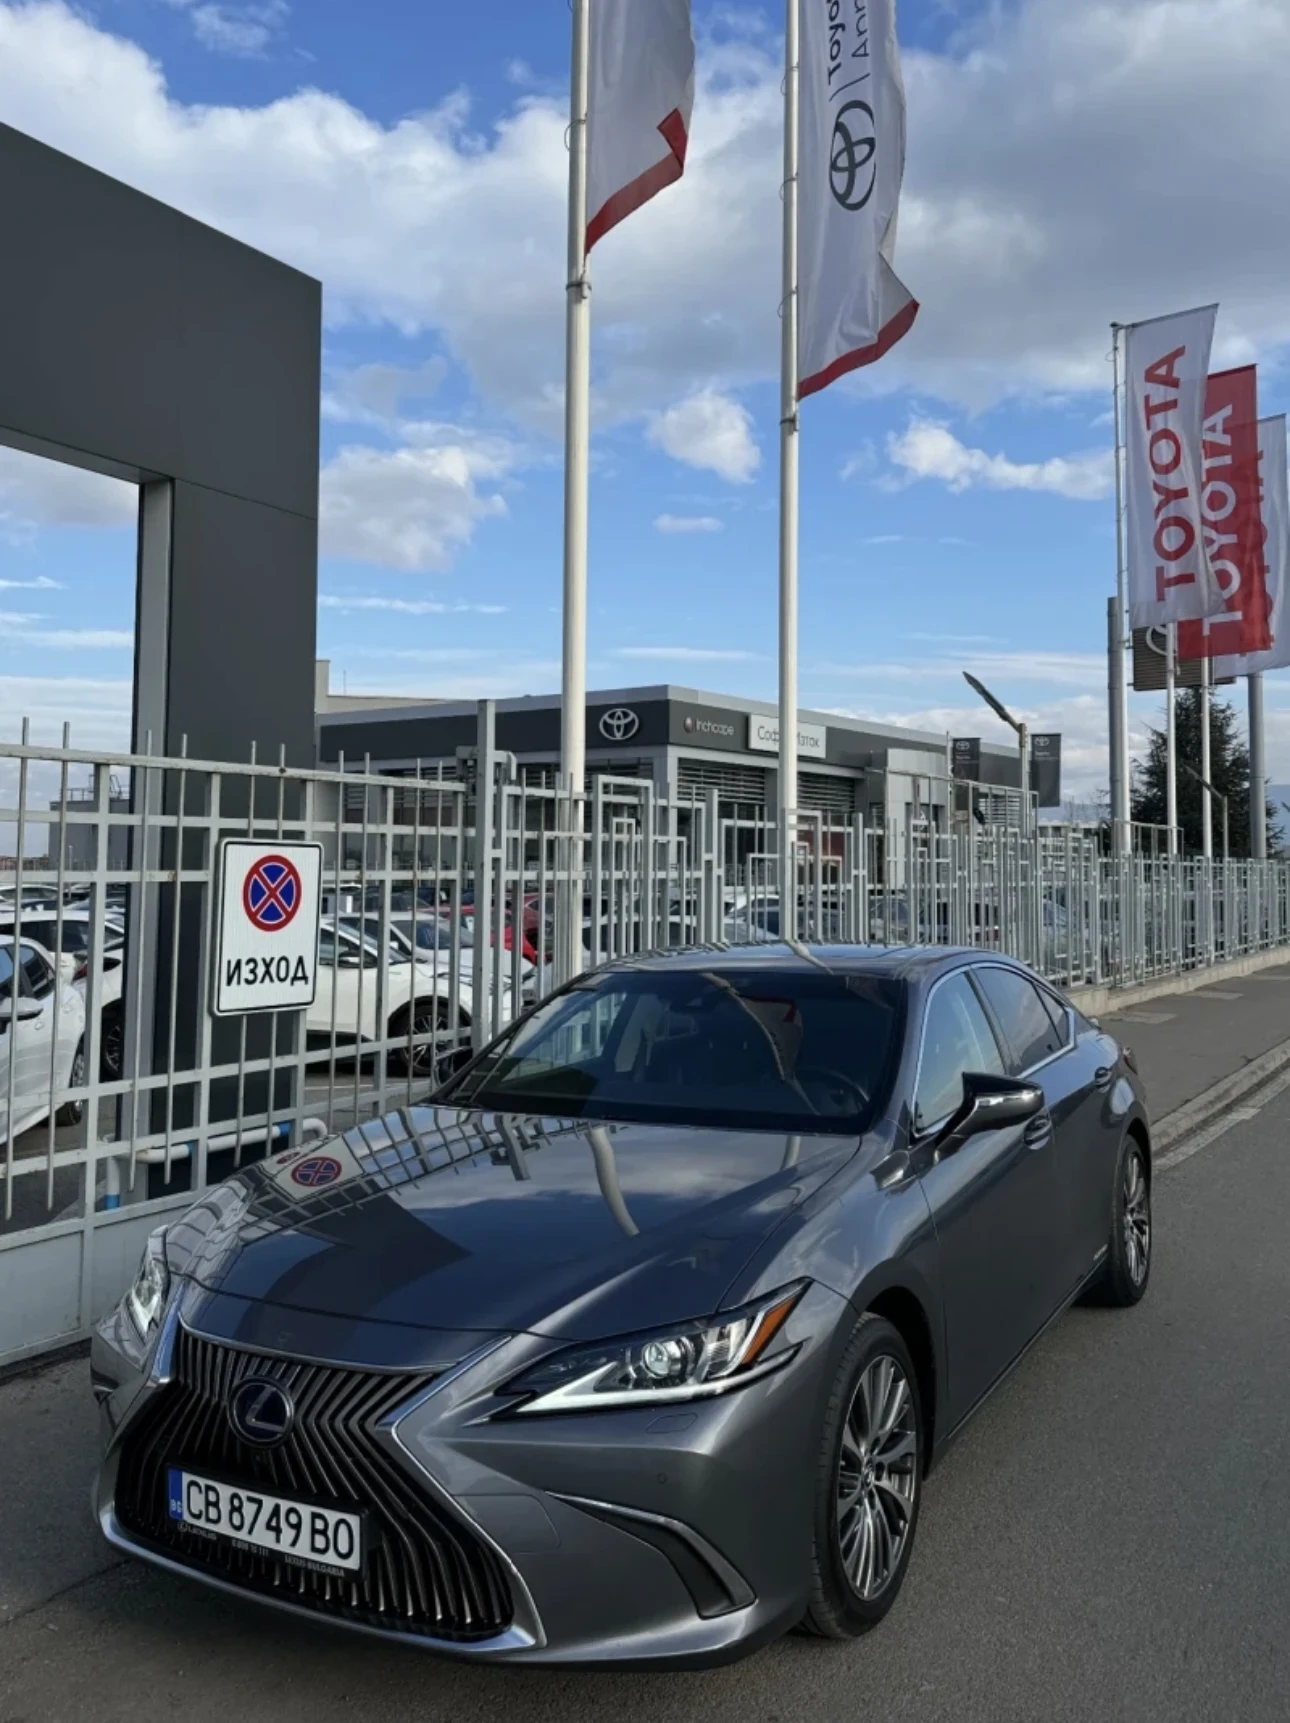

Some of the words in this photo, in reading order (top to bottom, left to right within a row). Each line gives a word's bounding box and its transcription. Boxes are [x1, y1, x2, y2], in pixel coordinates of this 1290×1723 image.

[827, 0, 846, 85] Toyo
[1143, 345, 1196, 603] TOYOTA
[226, 955, 309, 986] ИЗХОД
[186, 1479, 222, 1525] CB
[228, 1492, 302, 1548] 8749
